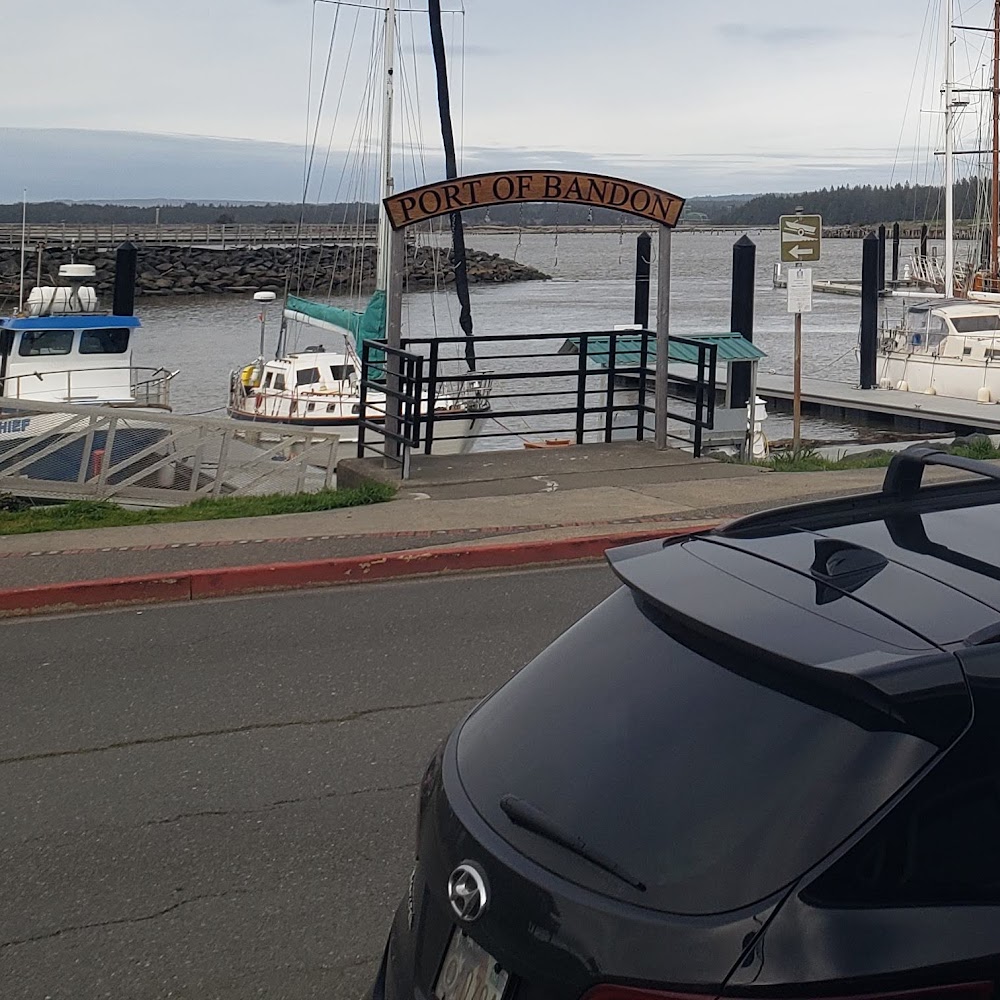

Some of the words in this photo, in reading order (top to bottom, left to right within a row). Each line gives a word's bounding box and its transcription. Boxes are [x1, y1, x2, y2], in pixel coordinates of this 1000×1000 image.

[397, 180, 482, 223] PORT
[492, 175, 533, 201] OF
[542, 175, 675, 220] BANDON
